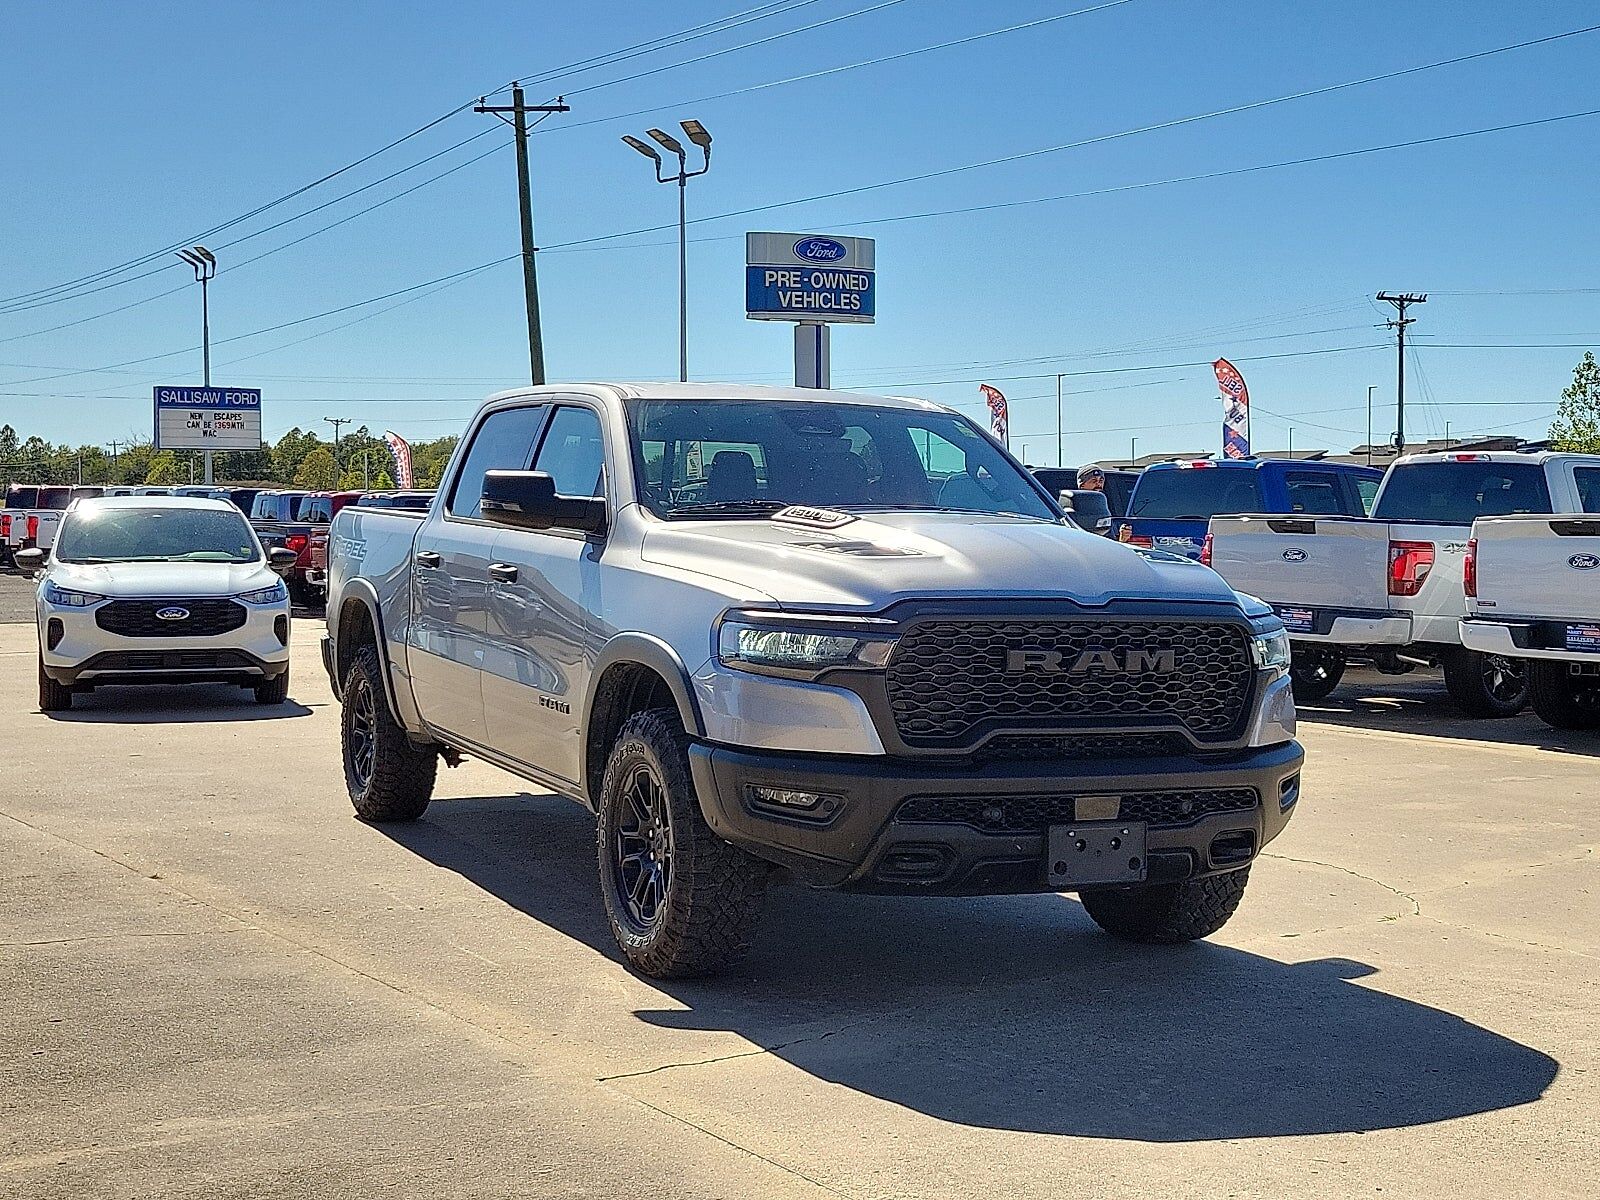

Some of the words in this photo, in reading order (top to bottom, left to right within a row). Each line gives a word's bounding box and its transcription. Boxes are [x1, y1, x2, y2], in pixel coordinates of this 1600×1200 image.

[806, 241, 838, 259] Ford
[764, 270, 869, 291] PRE-OWNED
[778, 291, 861, 310] VEHICLES
[160, 390, 220, 404] SALLISAW
[225, 392, 259, 405] FORD
[189, 412, 204, 420] NEW
[213, 412, 243, 421] ESCAPES
[186, 421, 201, 429] CAN
[203, 421, 212, 429] BE
[202, 429, 218, 438] WAC
[1443, 542, 1468, 554] 4x
[1572, 555, 1595, 567] Ford
[1006, 649, 1176, 673] RAM
[538, 694, 571, 715] RAM
